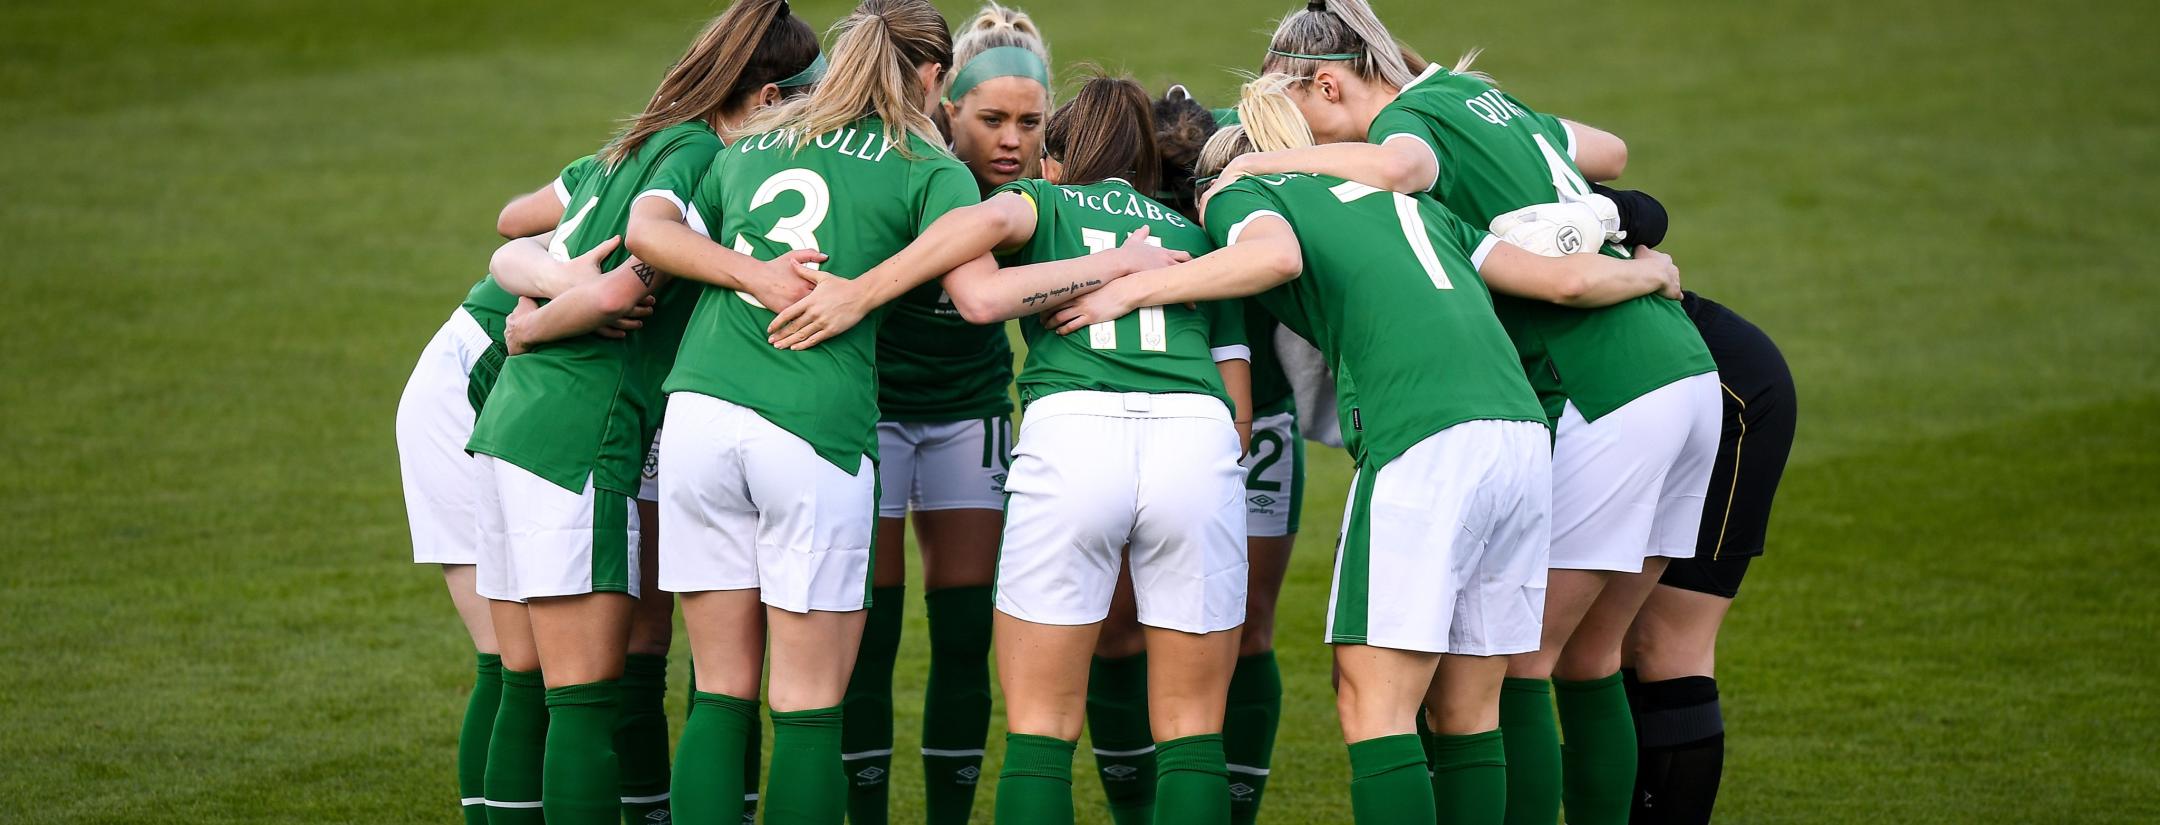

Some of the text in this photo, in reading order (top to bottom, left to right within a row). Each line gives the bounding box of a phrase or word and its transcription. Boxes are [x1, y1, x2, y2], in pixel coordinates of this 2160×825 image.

[734, 168, 830, 309] 3
[1081, 227, 1167, 352] 11
[1328, 181, 1455, 290] 7
[982, 416, 1012, 472] 10
[1246, 427, 1283, 492] 2
